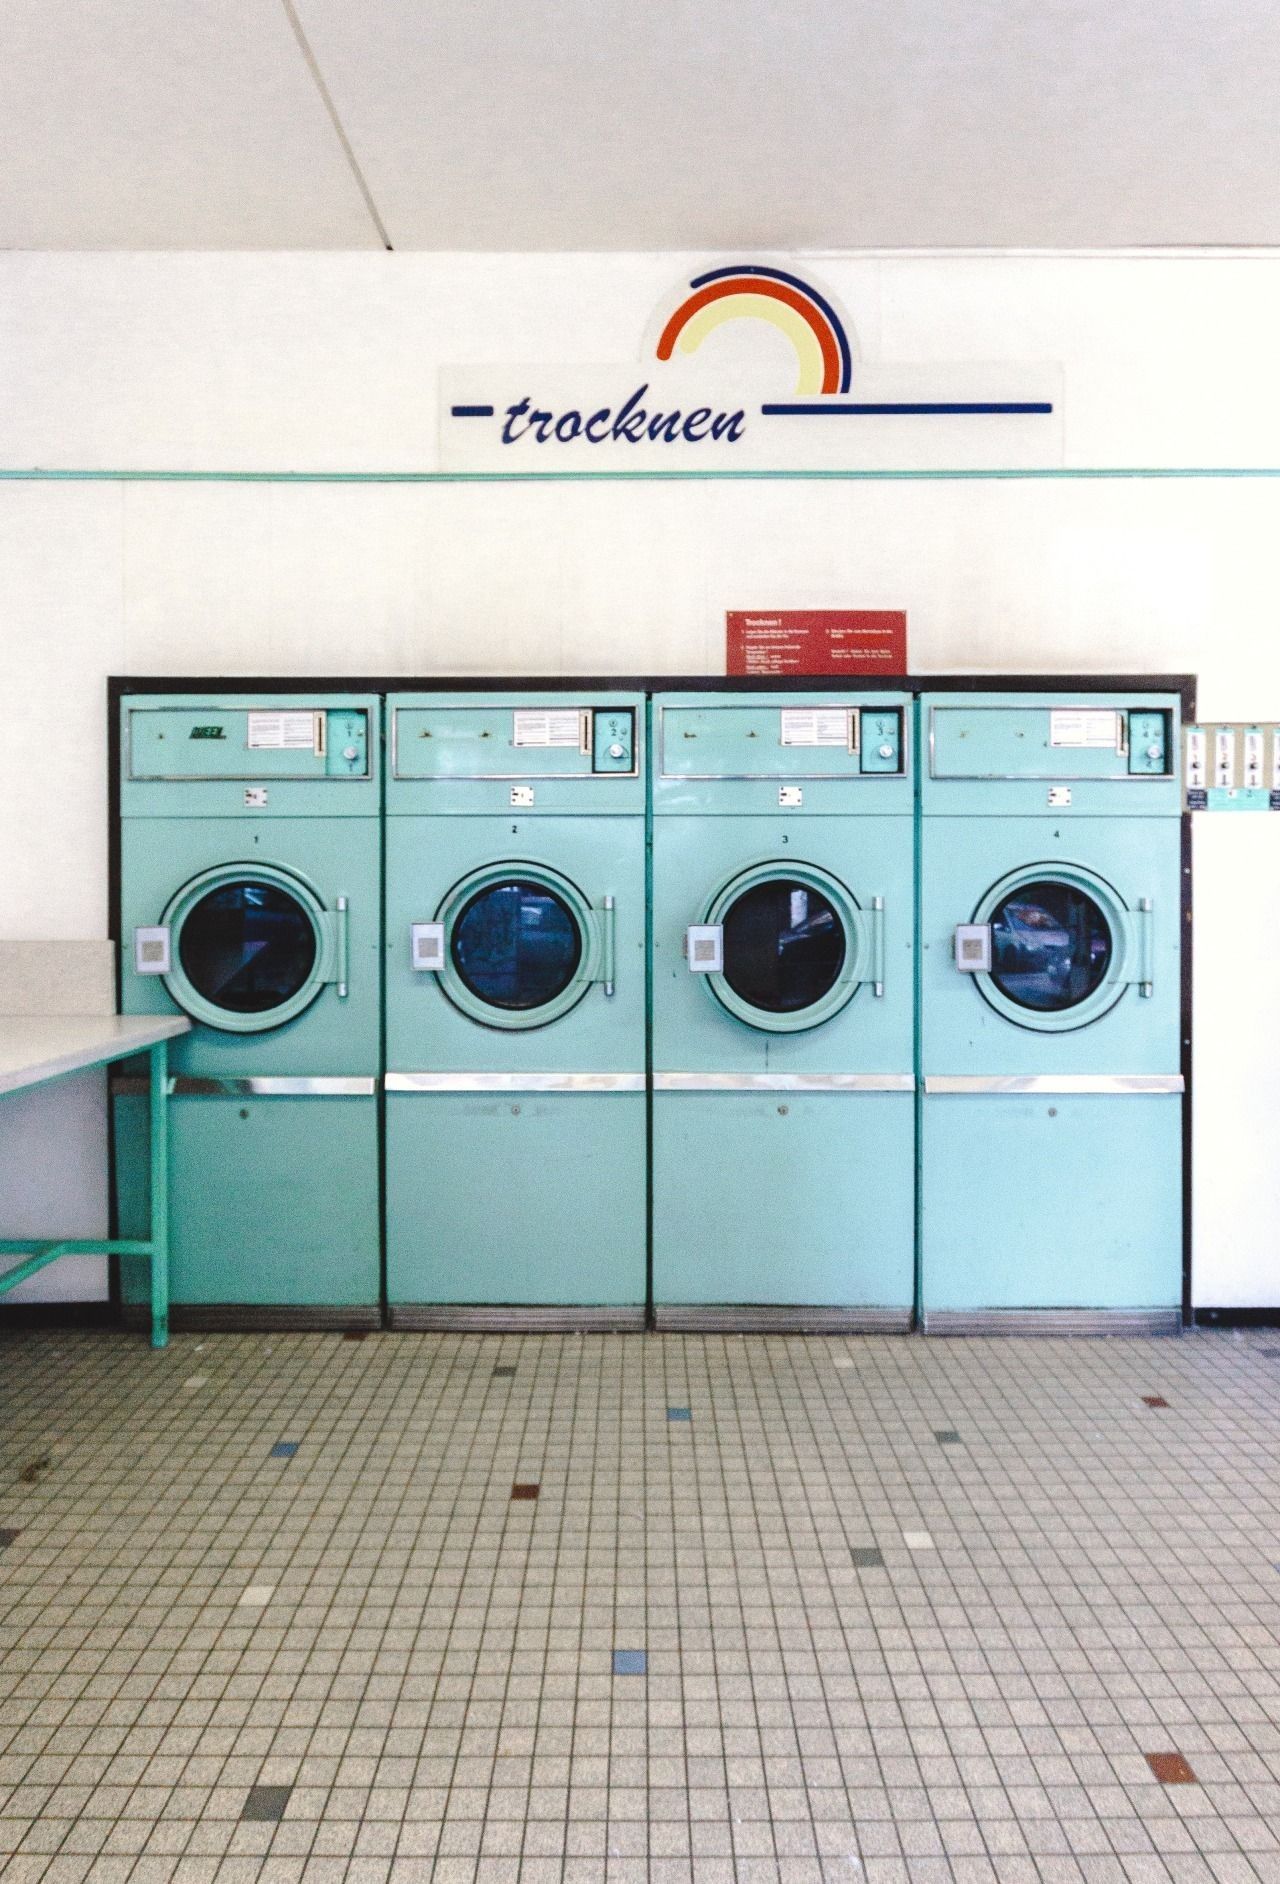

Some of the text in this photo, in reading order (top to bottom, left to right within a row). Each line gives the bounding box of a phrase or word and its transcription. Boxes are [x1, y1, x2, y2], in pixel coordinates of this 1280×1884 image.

[502, 383, 745, 445] trocknen
[511, 825, 518, 834] 2
[1053, 830, 1060, 838] 4
[782, 835, 789, 844] 3
